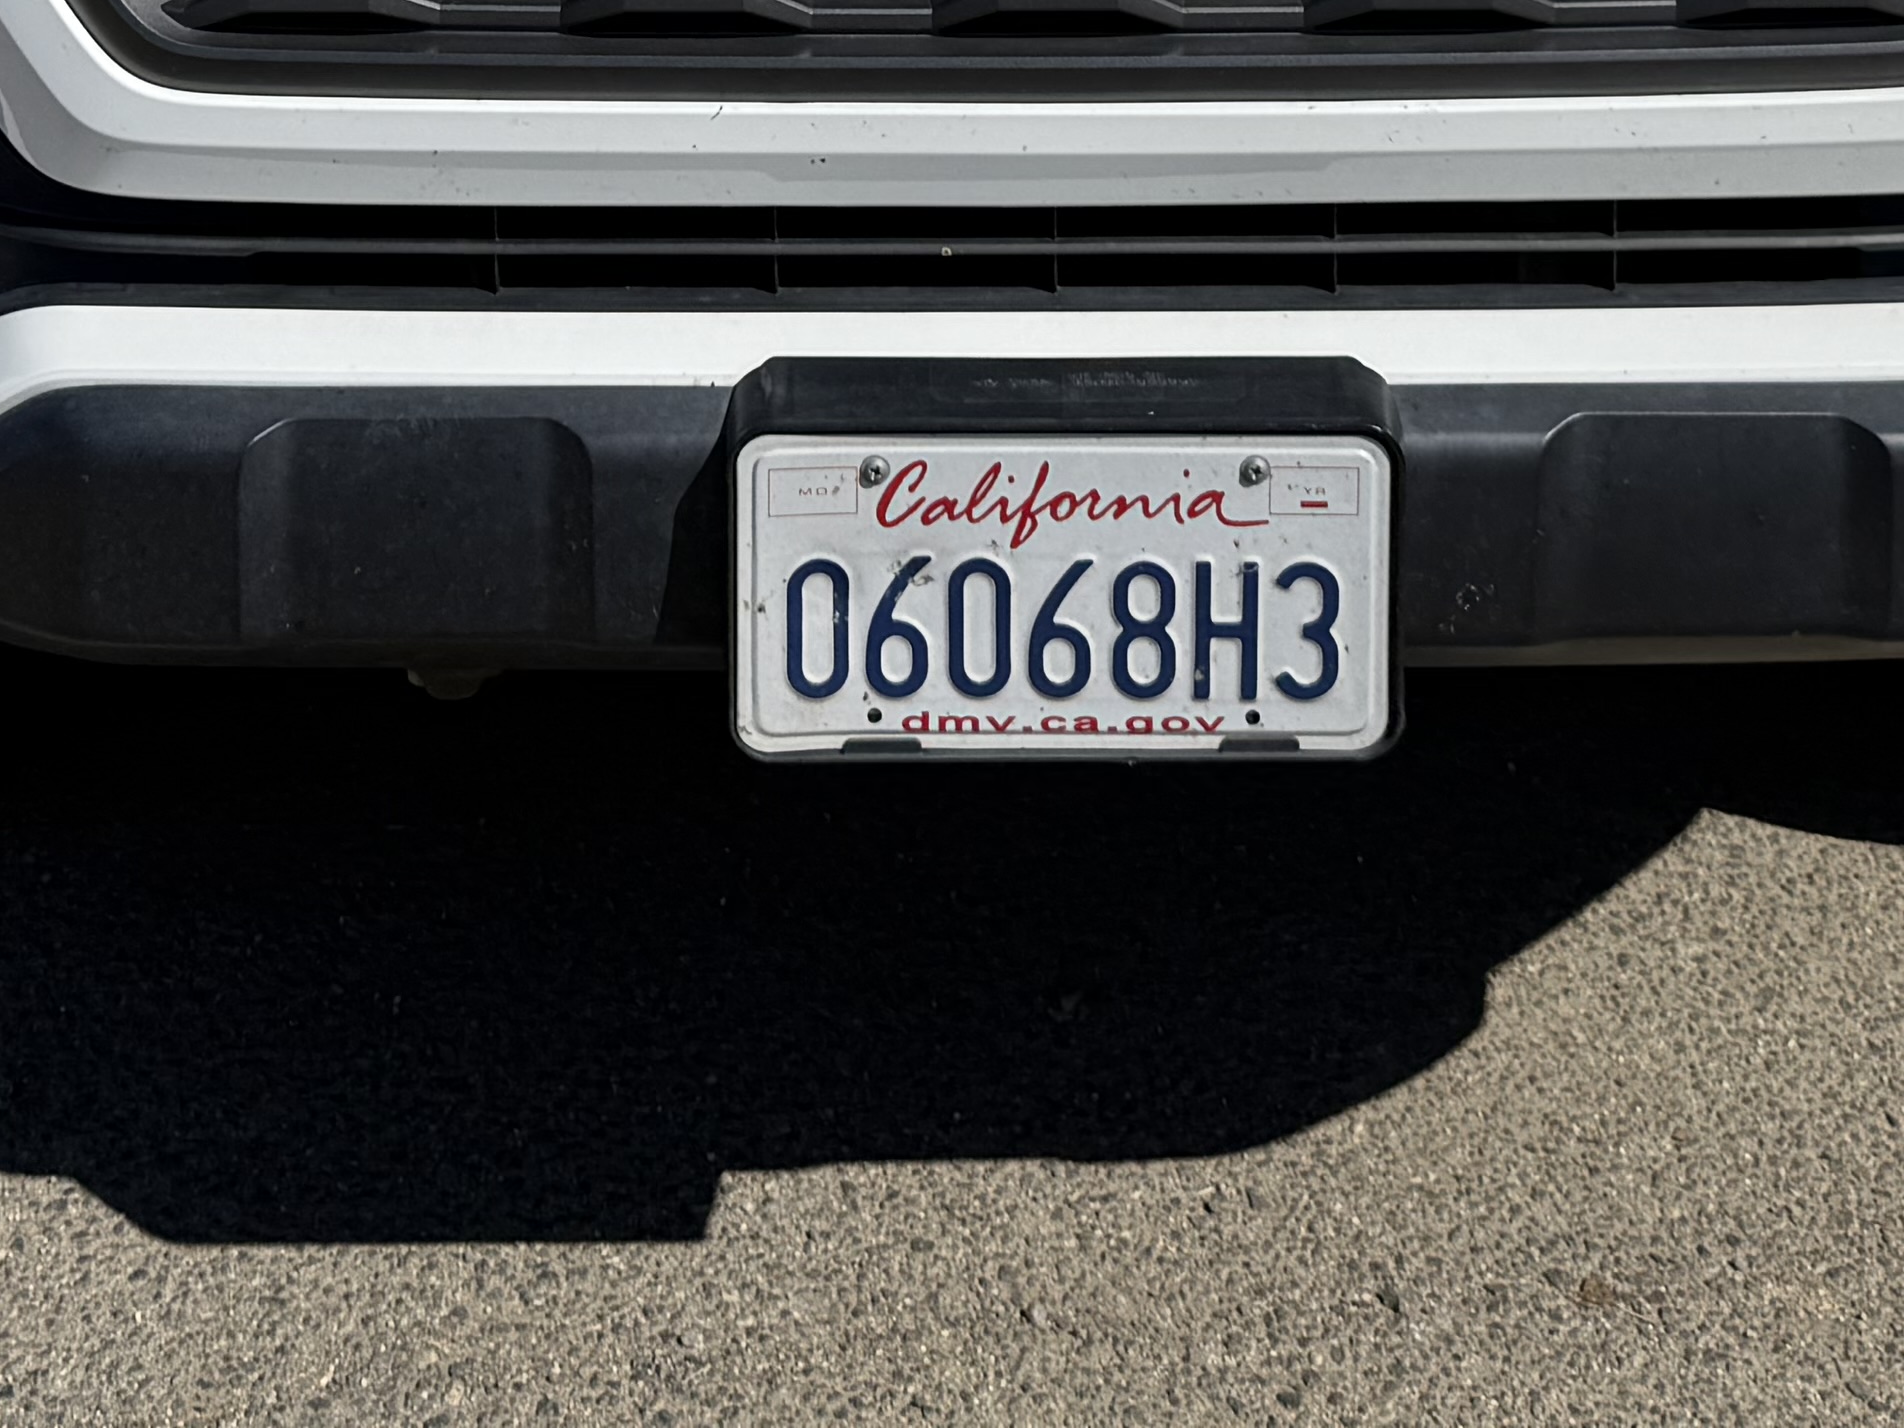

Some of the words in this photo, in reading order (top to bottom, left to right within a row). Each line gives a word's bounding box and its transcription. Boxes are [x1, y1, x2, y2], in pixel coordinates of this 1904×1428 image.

[876, 460, 1269, 548] California
[786, 556, 1340, 700] 06068H3
[902, 711, 1225, 733] dmv.ca.gov
